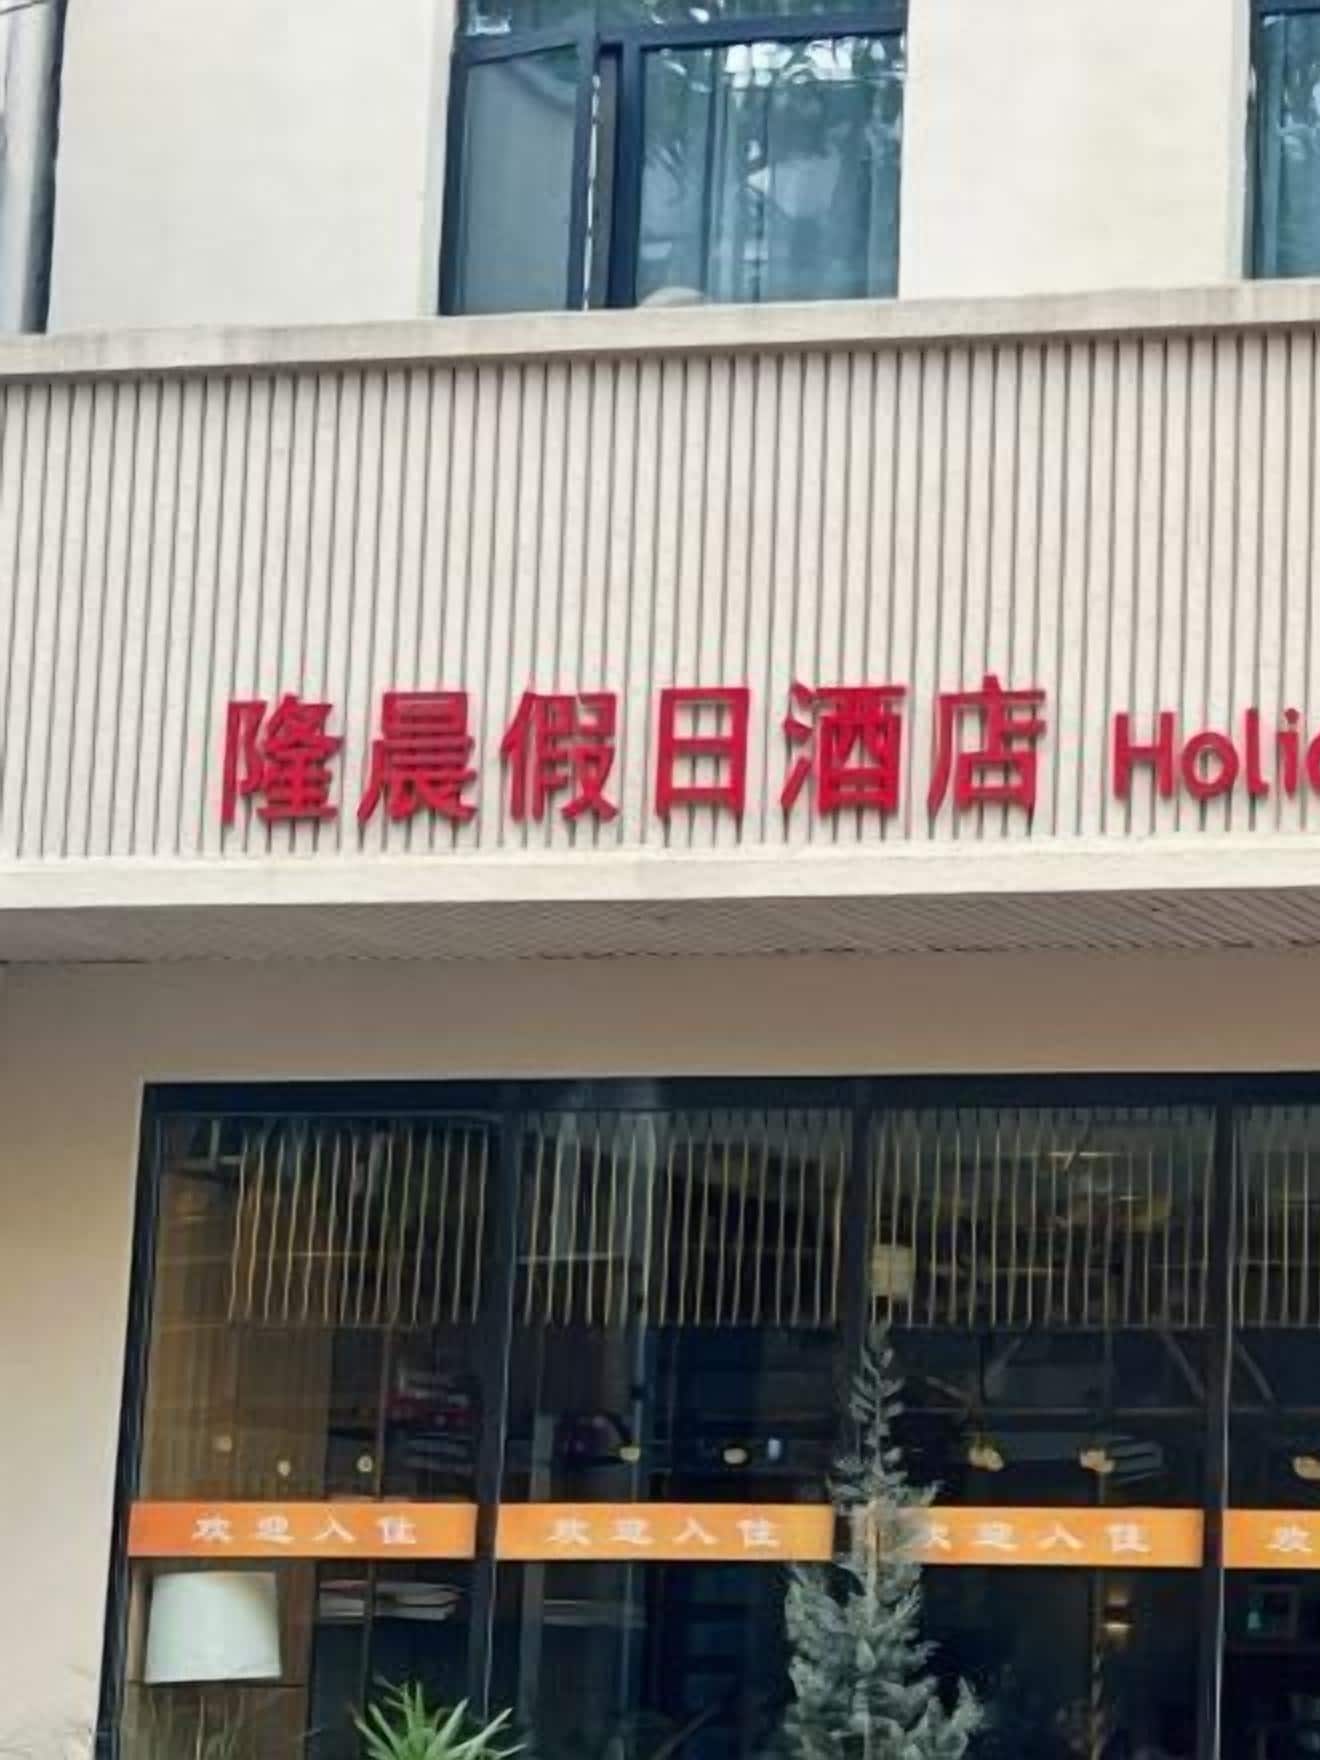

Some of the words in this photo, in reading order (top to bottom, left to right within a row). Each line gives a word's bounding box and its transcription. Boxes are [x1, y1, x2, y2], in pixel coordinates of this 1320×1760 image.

[222, 675, 1046, 825] 隆晨假日酒店
[191, 1512, 417, 1546] 欢迎入住
[545, 1516, 781, 1549] 欢迎入住
